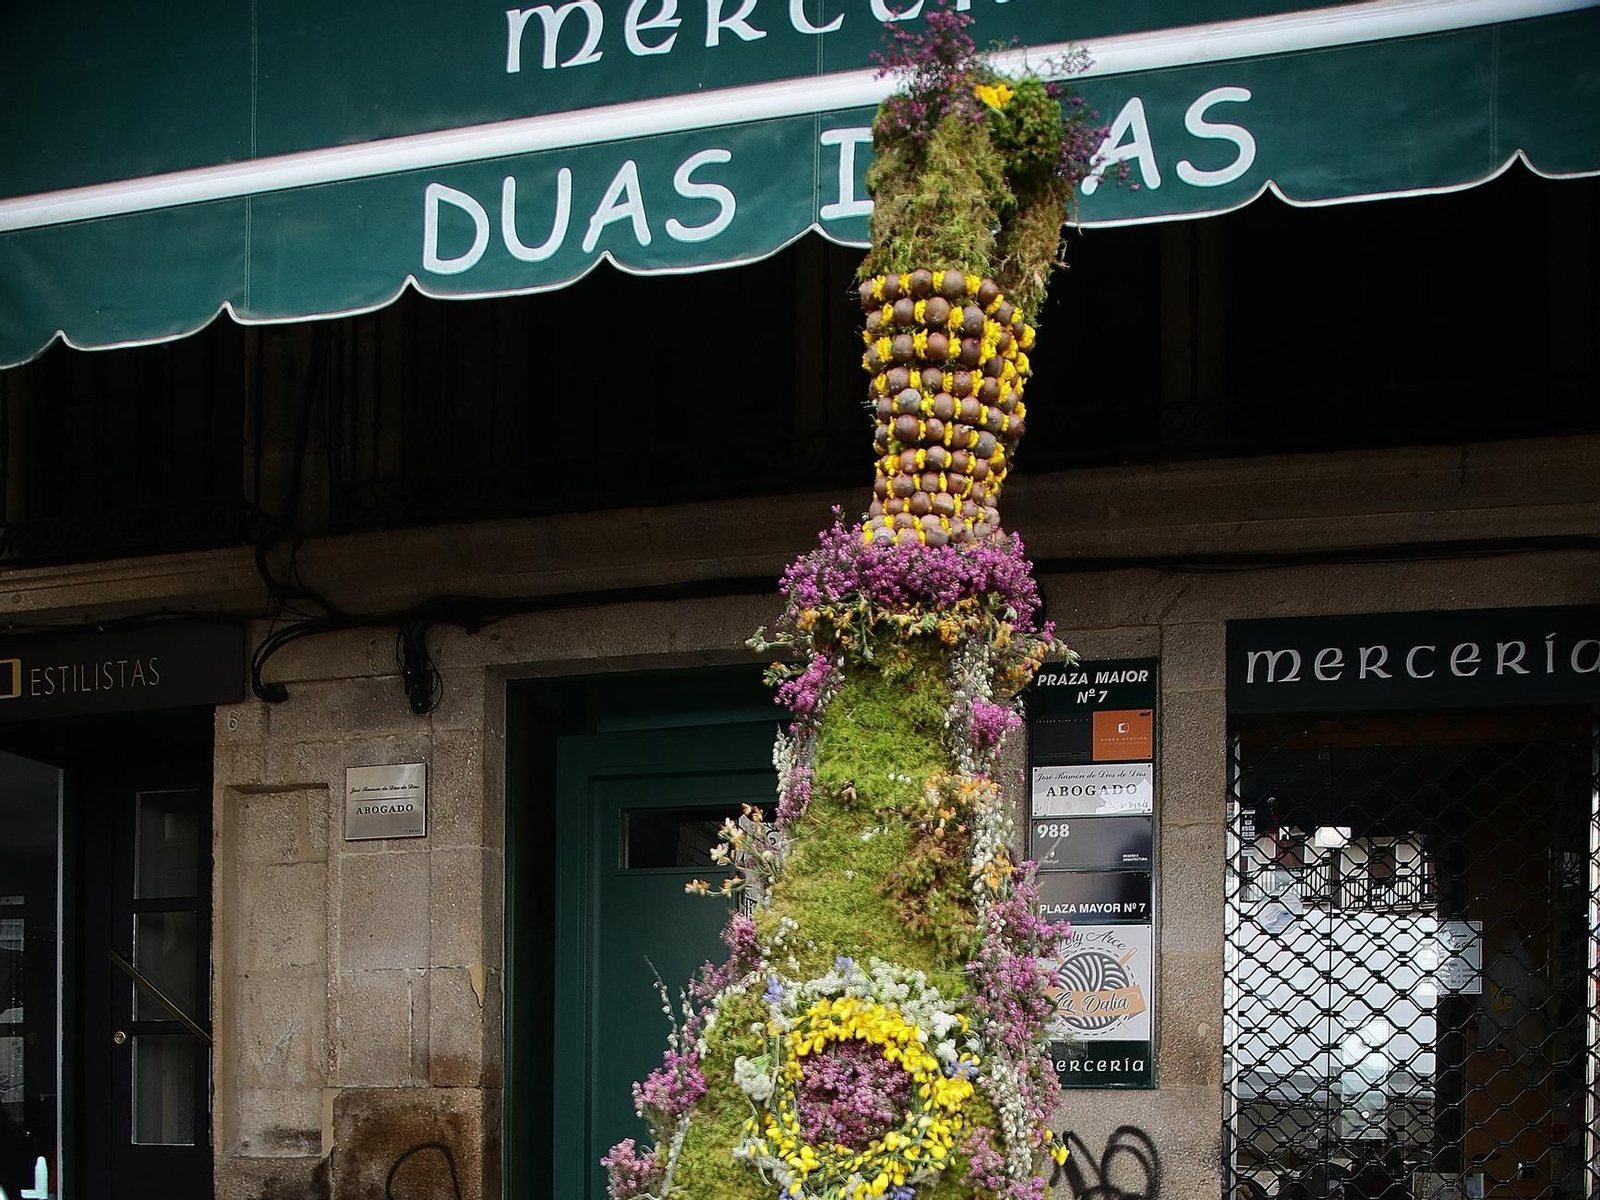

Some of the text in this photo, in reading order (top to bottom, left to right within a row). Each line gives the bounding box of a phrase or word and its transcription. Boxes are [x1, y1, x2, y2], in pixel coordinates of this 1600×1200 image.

[422, 86, 1257, 275] DUAS IAS
[30, 657, 160, 696] ESTILISTAS
[1037, 670, 1149, 687] PRAZA MAIOR
[1098, 690, 1108, 703] 7
[228, 709, 238, 731] 6
[1046, 783, 1137, 797] ABOGADO
[356, 804, 414, 815] ABOGADO
[1037, 823, 1070, 838] 988
[1040, 903, 1076, 914] PLAZA
[1079, 903, 1121, 914] MAYOR
[1139, 903, 1146, 912] 7
[1086, 930, 1127, 950] Arce
[1082, 993, 1128, 1014] Dalia
[1056, 1058, 1144, 1072] ercería
